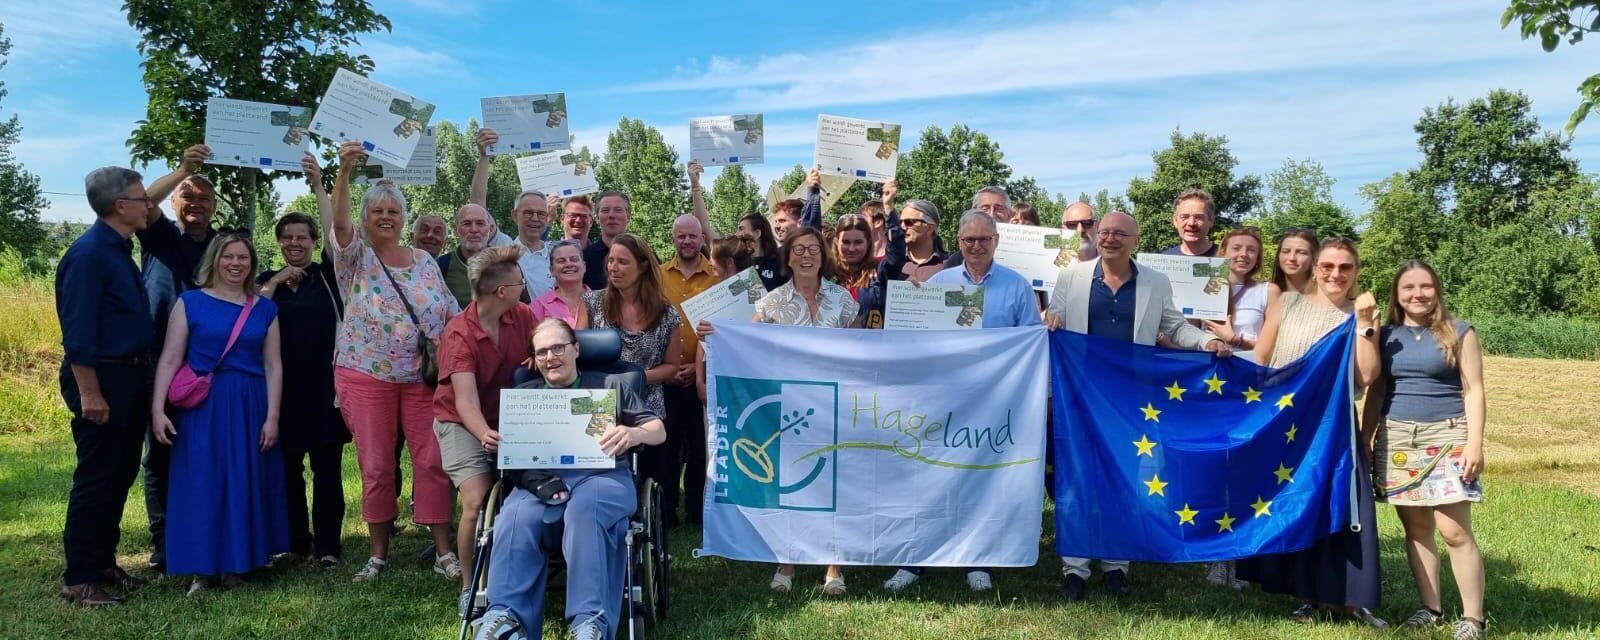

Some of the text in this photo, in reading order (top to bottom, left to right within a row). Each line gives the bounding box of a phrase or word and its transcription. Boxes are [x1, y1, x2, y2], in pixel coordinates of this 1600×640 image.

[533, 402, 567, 412] platteland
[851, 392, 1015, 458] Hageland
[716, 405, 728, 497] LEADER
